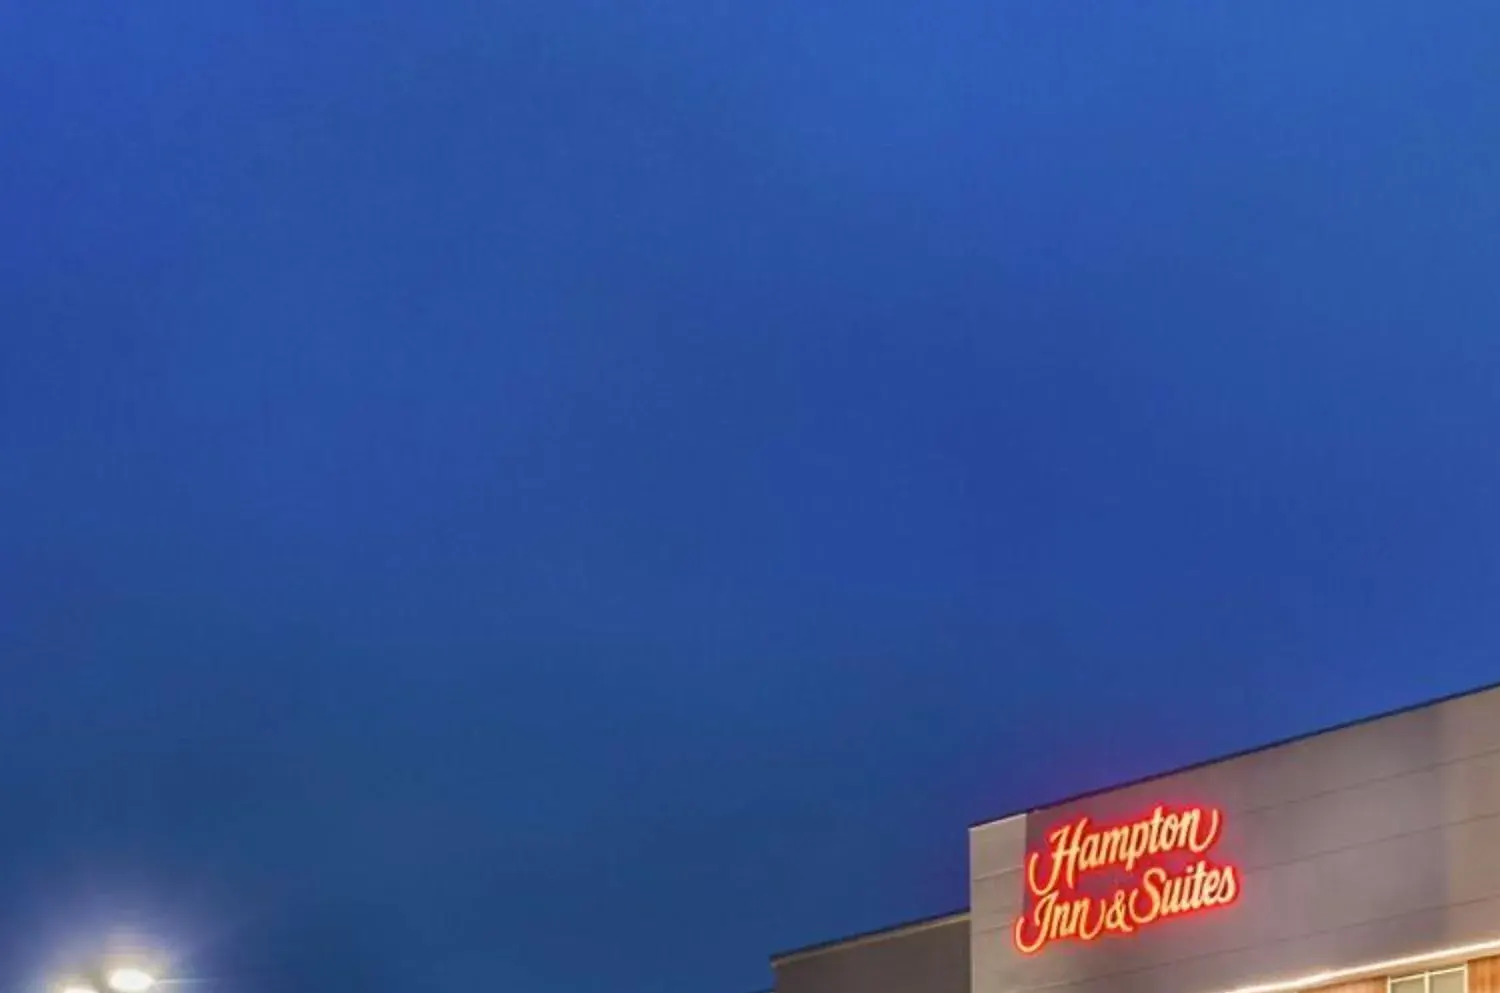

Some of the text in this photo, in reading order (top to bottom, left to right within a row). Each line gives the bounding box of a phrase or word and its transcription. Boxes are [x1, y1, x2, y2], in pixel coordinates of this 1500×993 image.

[1029, 806, 1219, 896] Hampton
[1015, 861, 1237, 953] Inn & Suites
